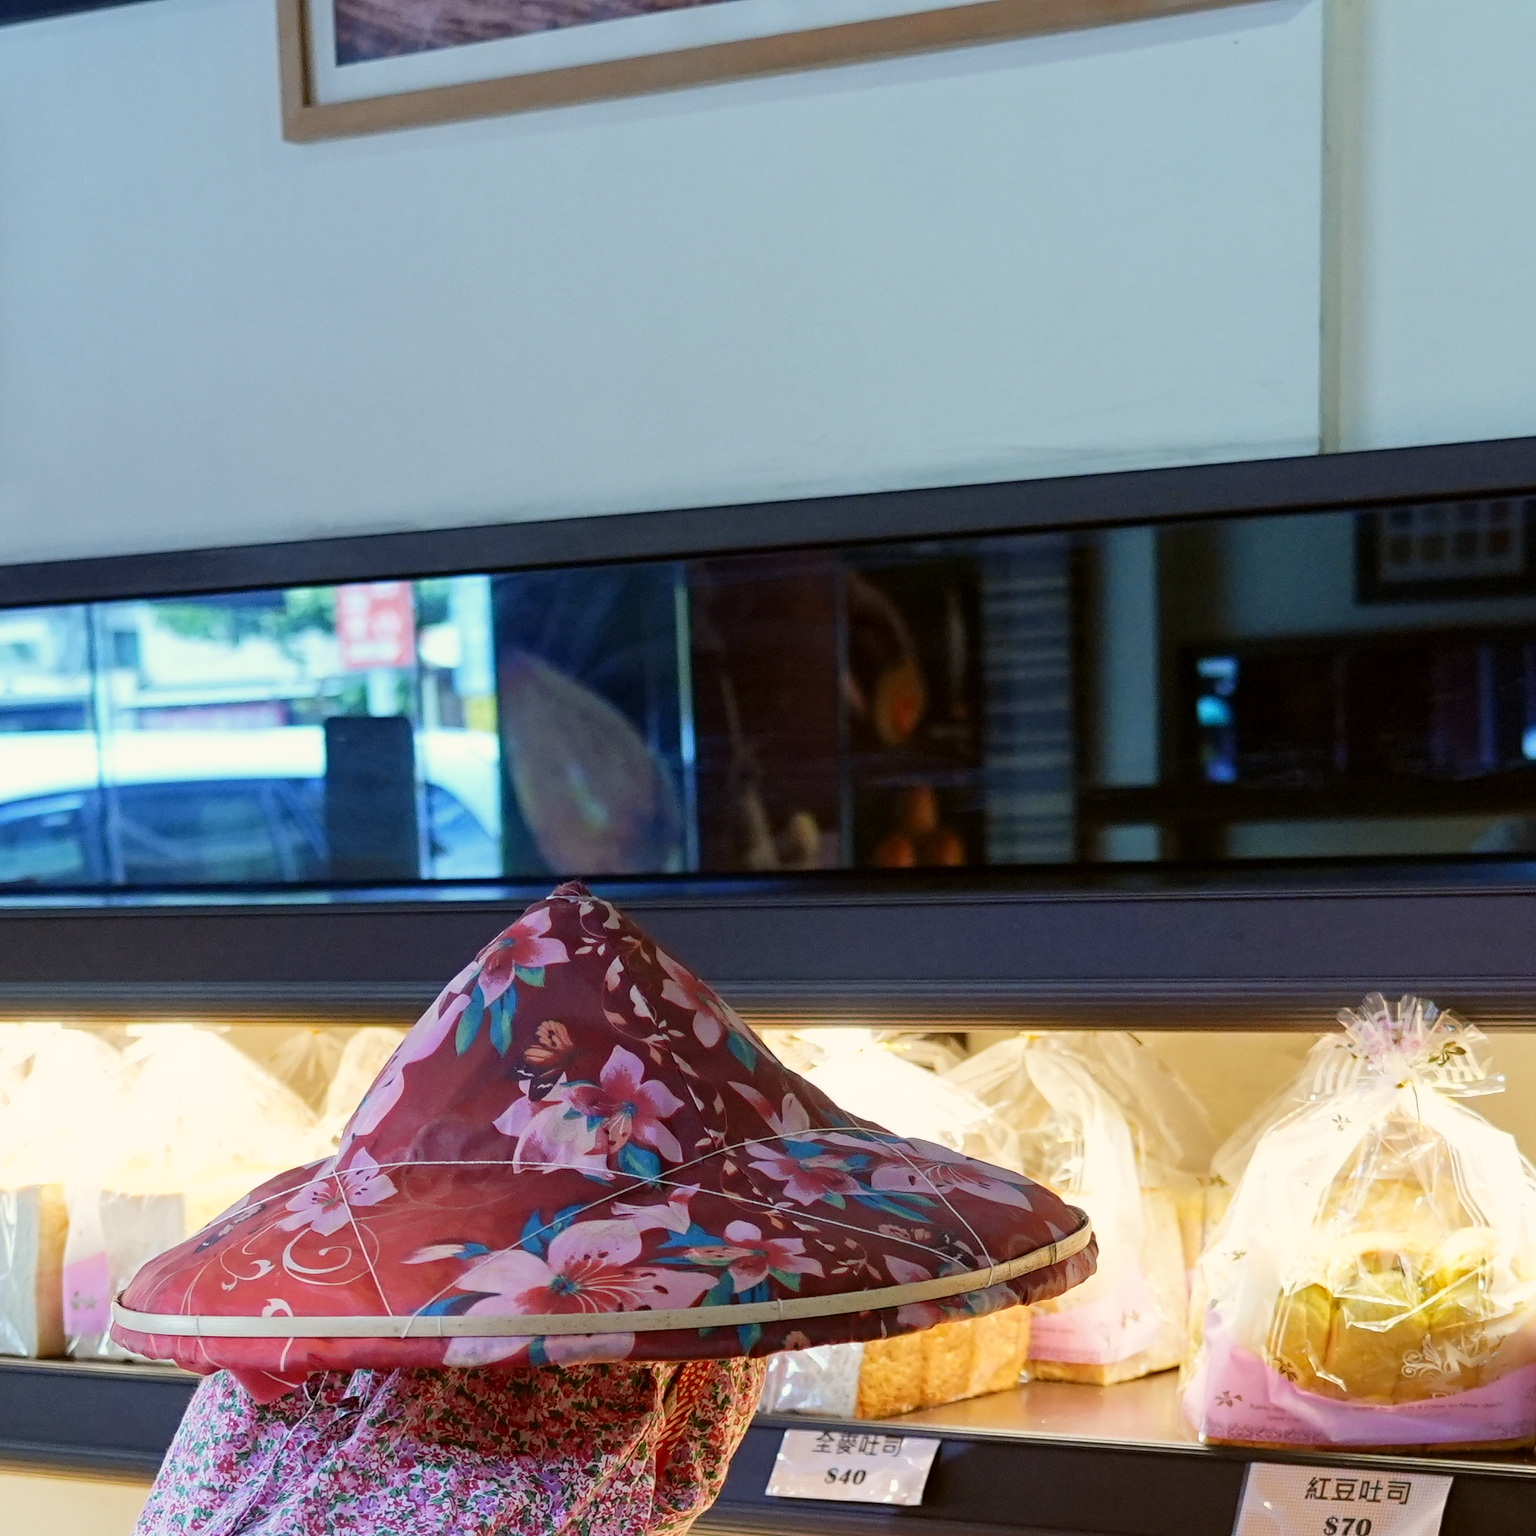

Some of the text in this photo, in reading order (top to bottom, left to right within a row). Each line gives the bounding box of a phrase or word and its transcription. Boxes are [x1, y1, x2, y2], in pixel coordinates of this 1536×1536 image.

[812, 1431, 902, 1458] 全麥吐司
[824, 1467, 867, 1485] $40
[1303, 1477, 1411, 1506] 紅豆吐司
